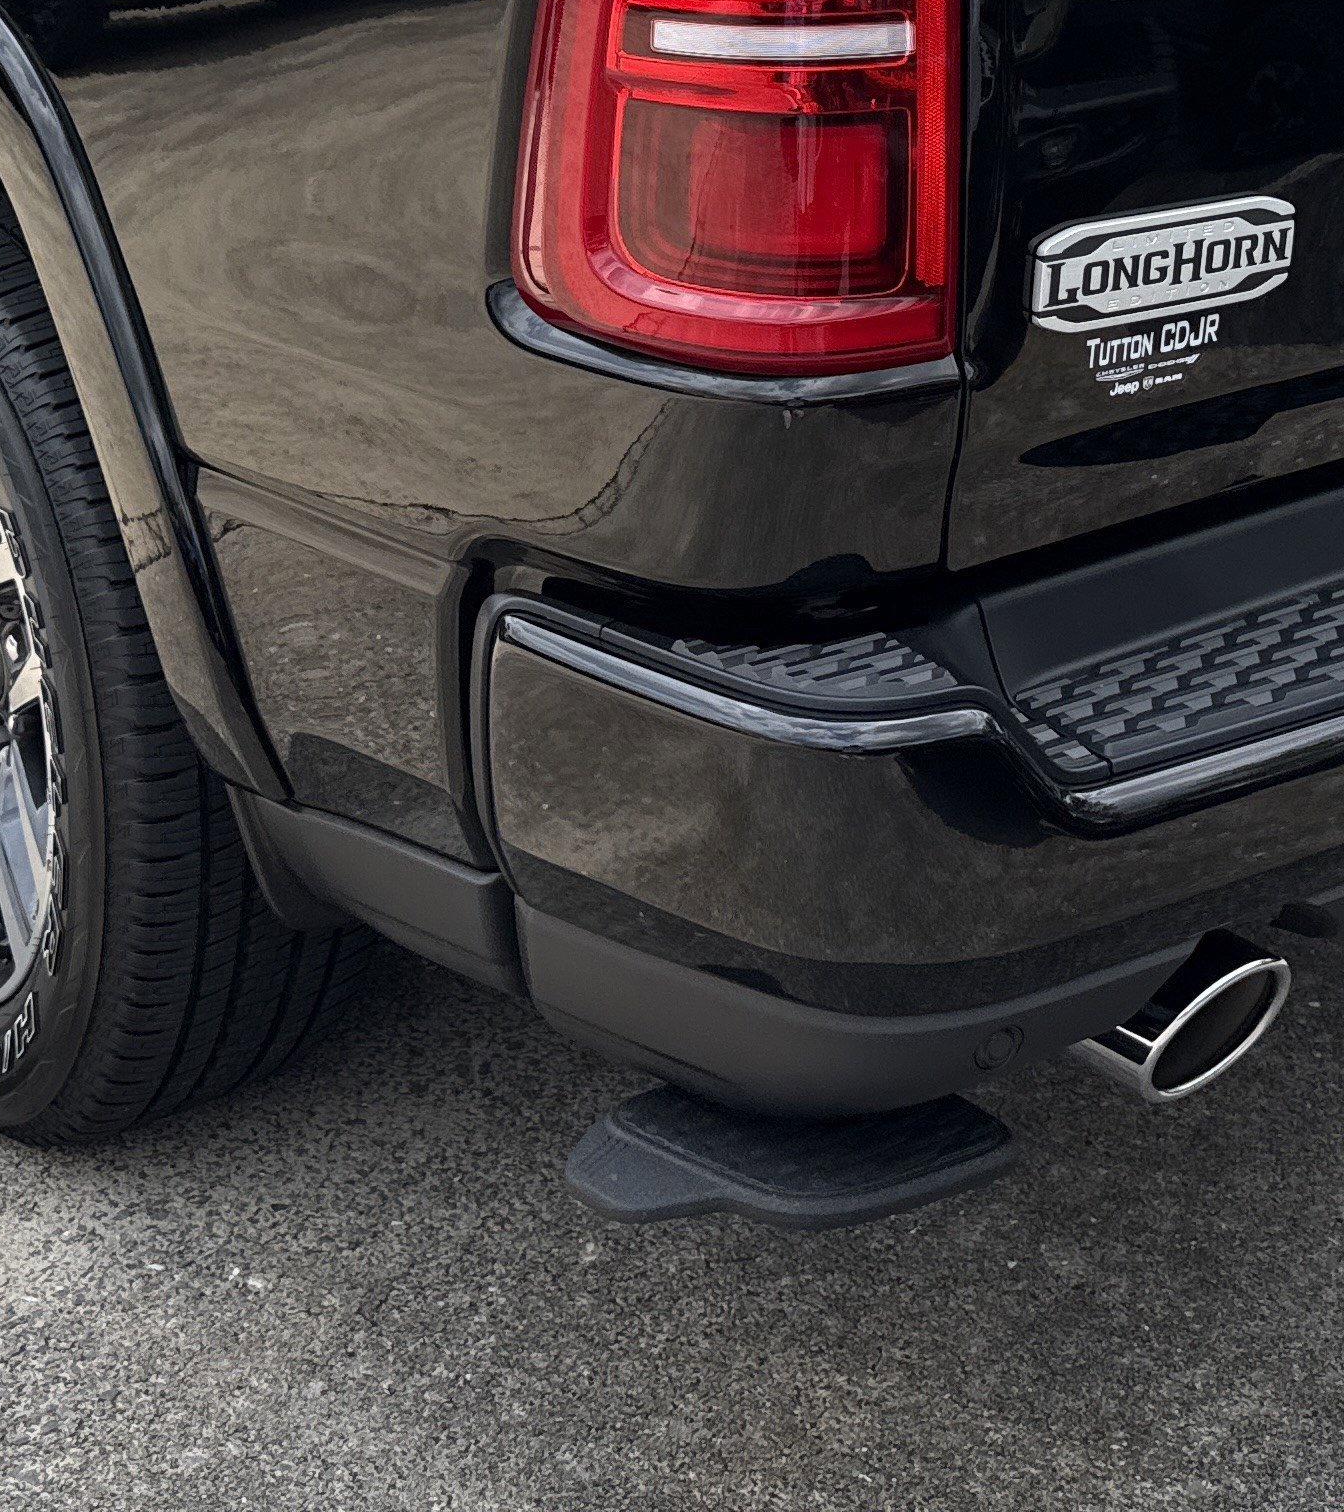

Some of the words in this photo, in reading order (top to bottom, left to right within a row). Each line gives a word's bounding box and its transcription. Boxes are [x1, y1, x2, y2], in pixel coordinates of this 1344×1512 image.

[1111, 220, 1236, 252] LIMITED
[1042, 227, 1293, 309] LONGHORN
[1107, 280, 1231, 311] EDITION
[1086, 337, 1155, 369] TUTTON
[1159, 313, 1220, 354] CDJR
[1095, 362, 1146, 379] CHRYSLER
[1109, 380, 1141, 397] Jeep
[1154, 372, 1184, 385] RAM
